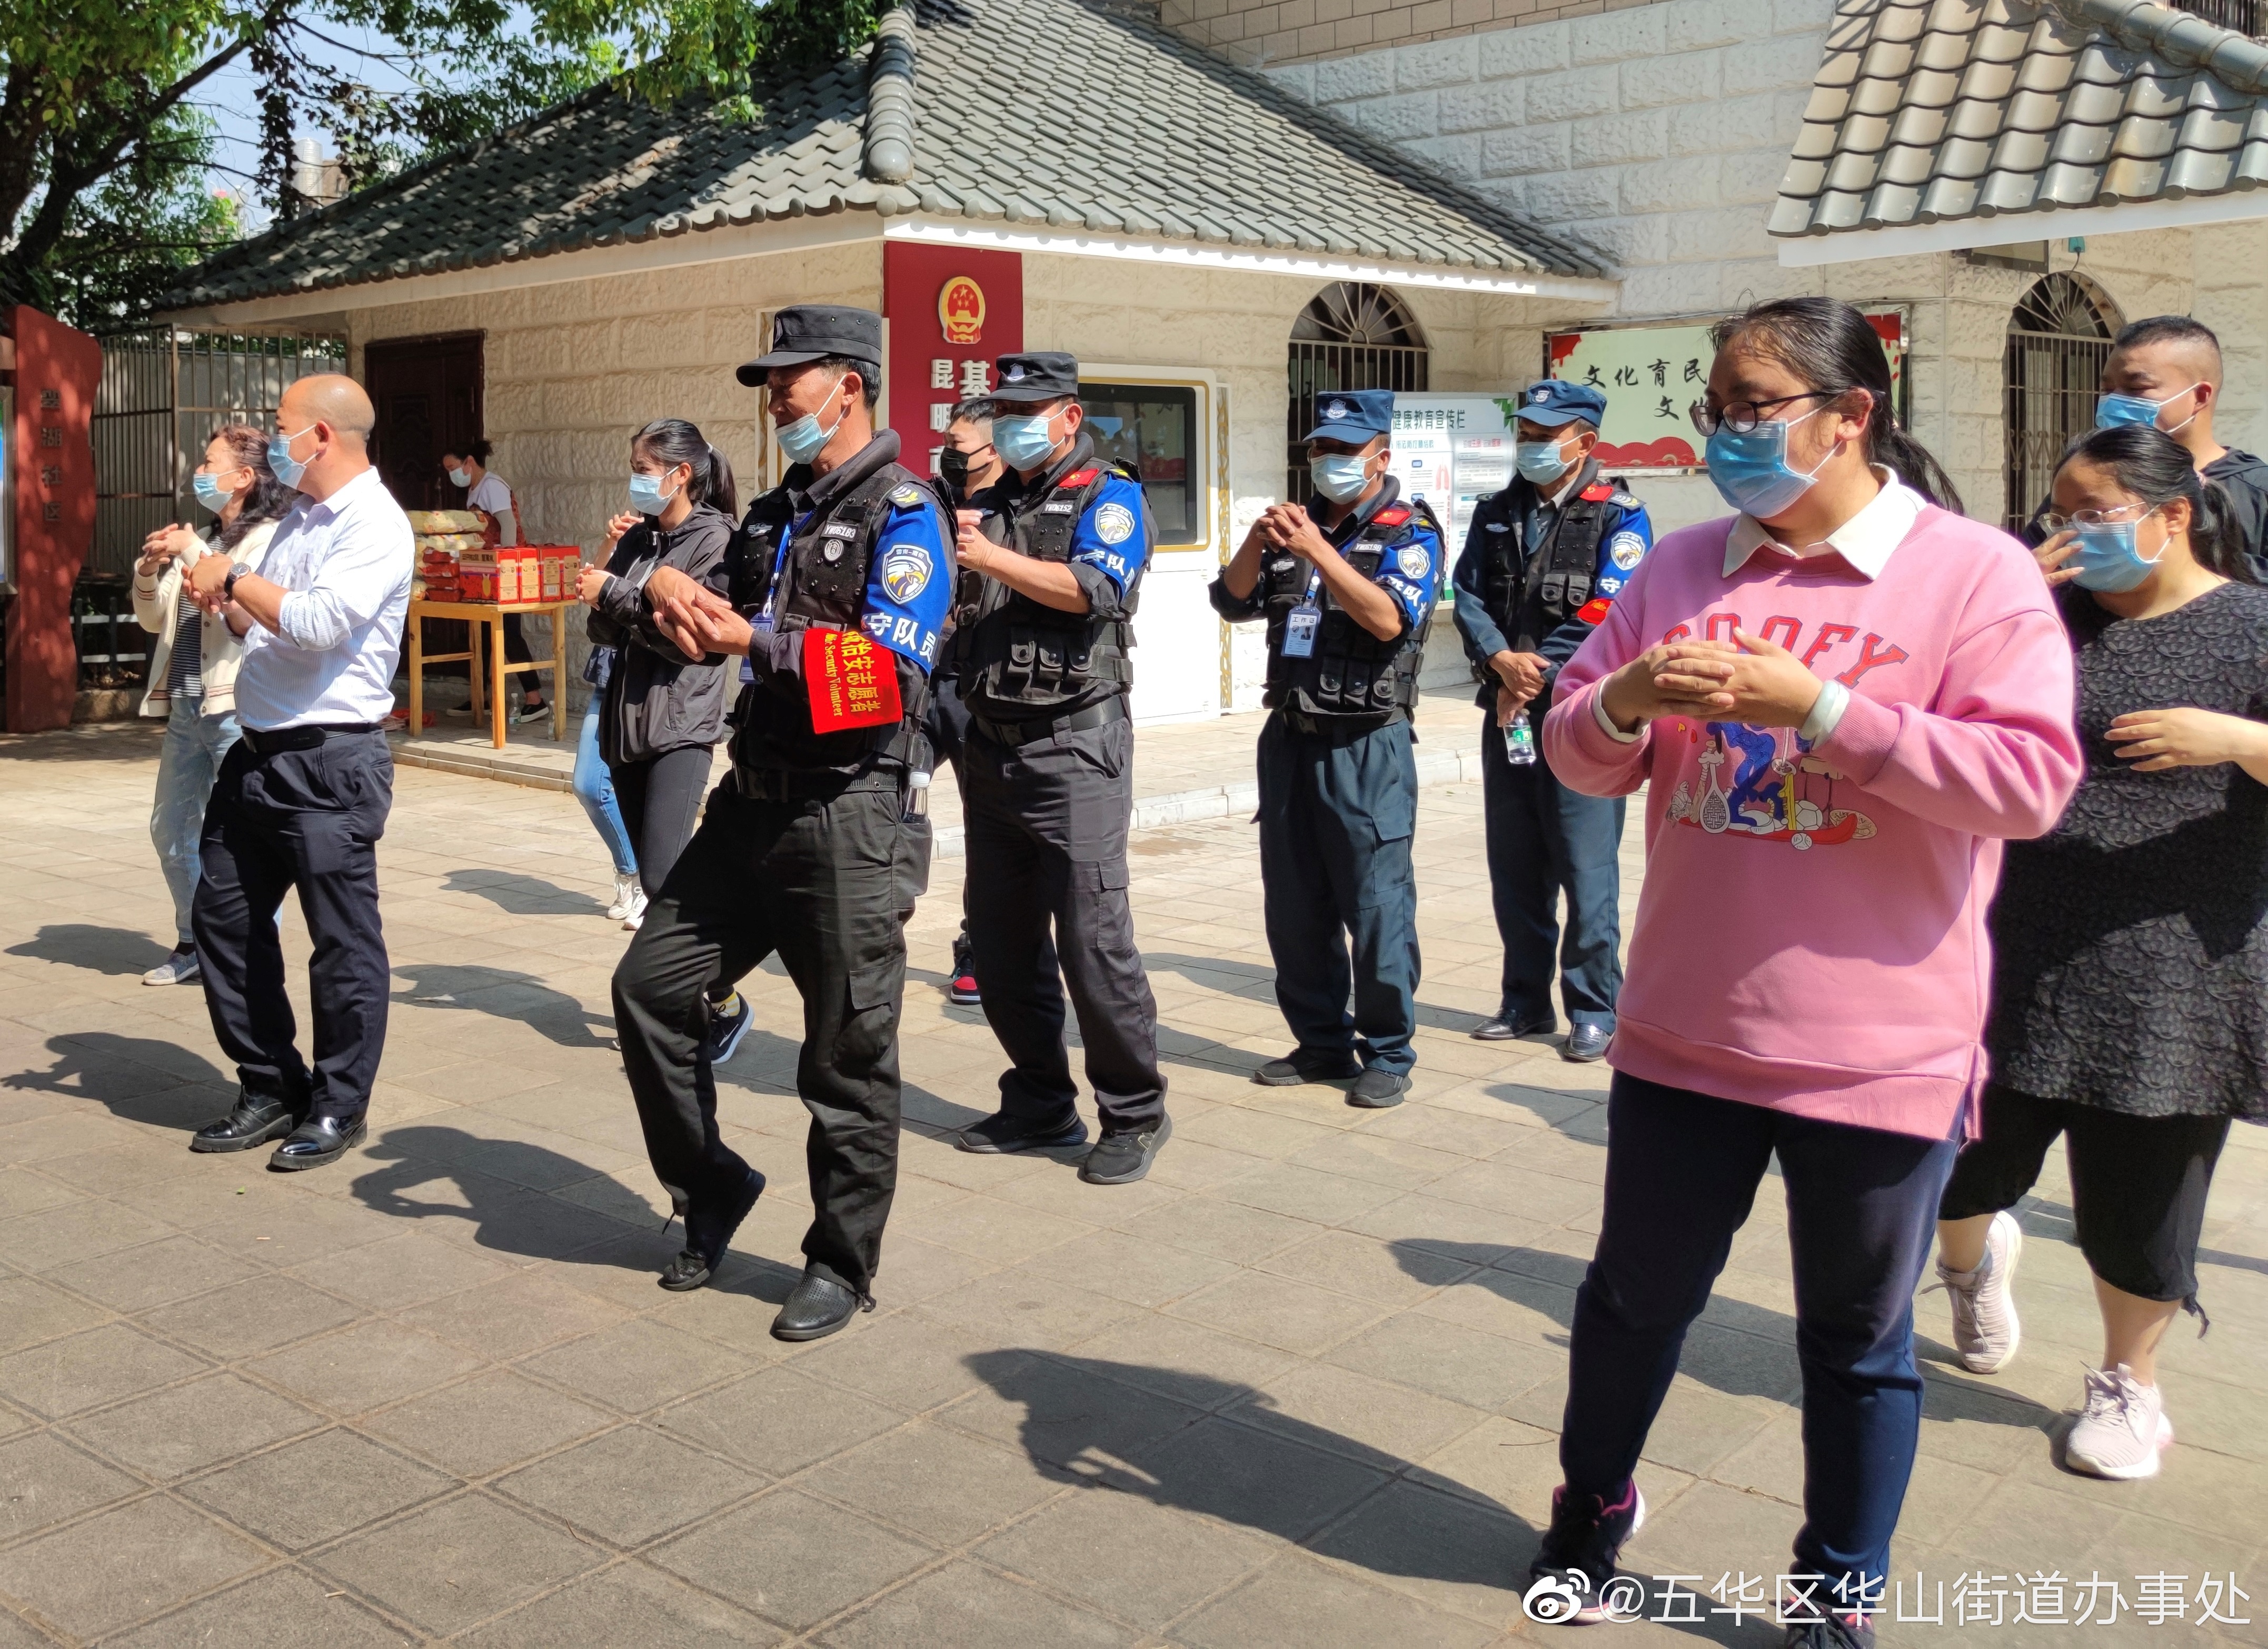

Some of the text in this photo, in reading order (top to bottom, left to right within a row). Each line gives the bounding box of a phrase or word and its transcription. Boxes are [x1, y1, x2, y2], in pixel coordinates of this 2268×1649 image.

[959, 359, 991, 400] 基
[1581, 358, 1707, 388] 文化育民
[1392, 409, 1466, 429] 健康教育宣传栏
[1600, 577, 1629, 594] 守
[862, 612, 936, 663] 守队员
[824, 645, 838, 677] Security
[829, 677, 843, 716] Volunteer
